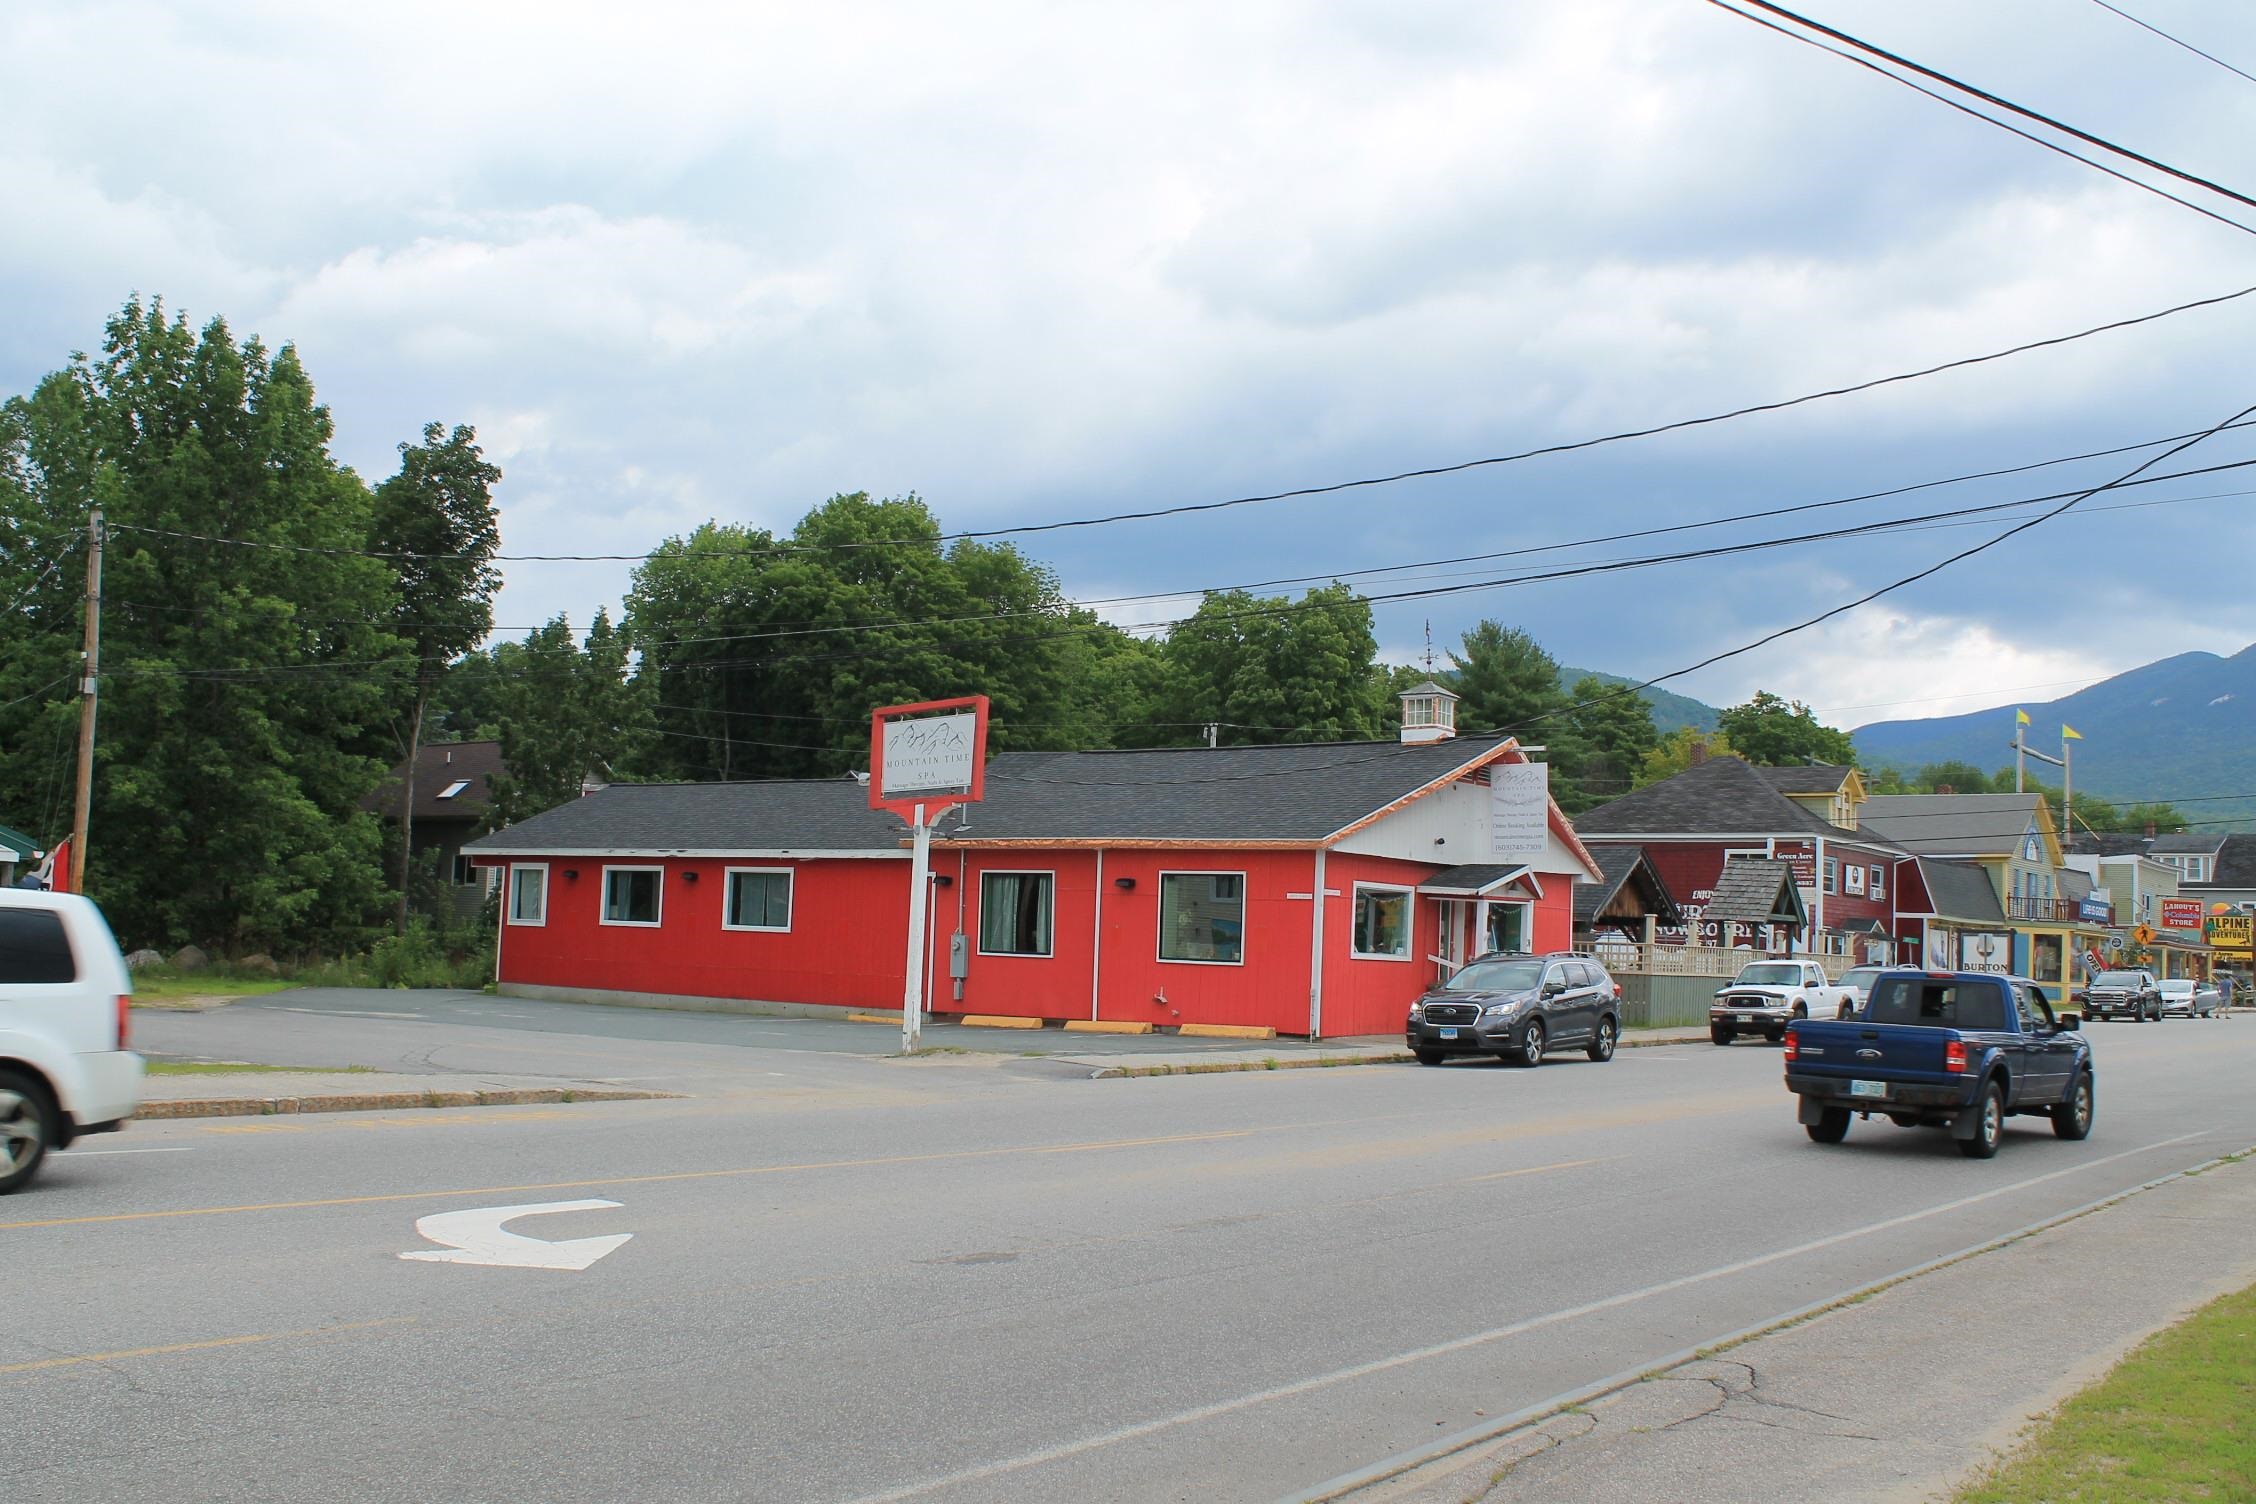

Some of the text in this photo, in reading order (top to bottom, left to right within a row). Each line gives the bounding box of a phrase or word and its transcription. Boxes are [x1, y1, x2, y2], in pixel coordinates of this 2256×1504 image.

[886, 753, 970, 768] MOUNTAIN TIME
[918, 771, 936, 780] SPA
[1776, 852, 1797, 860] Green
[1964, 962, 2008, 972] BURTON
